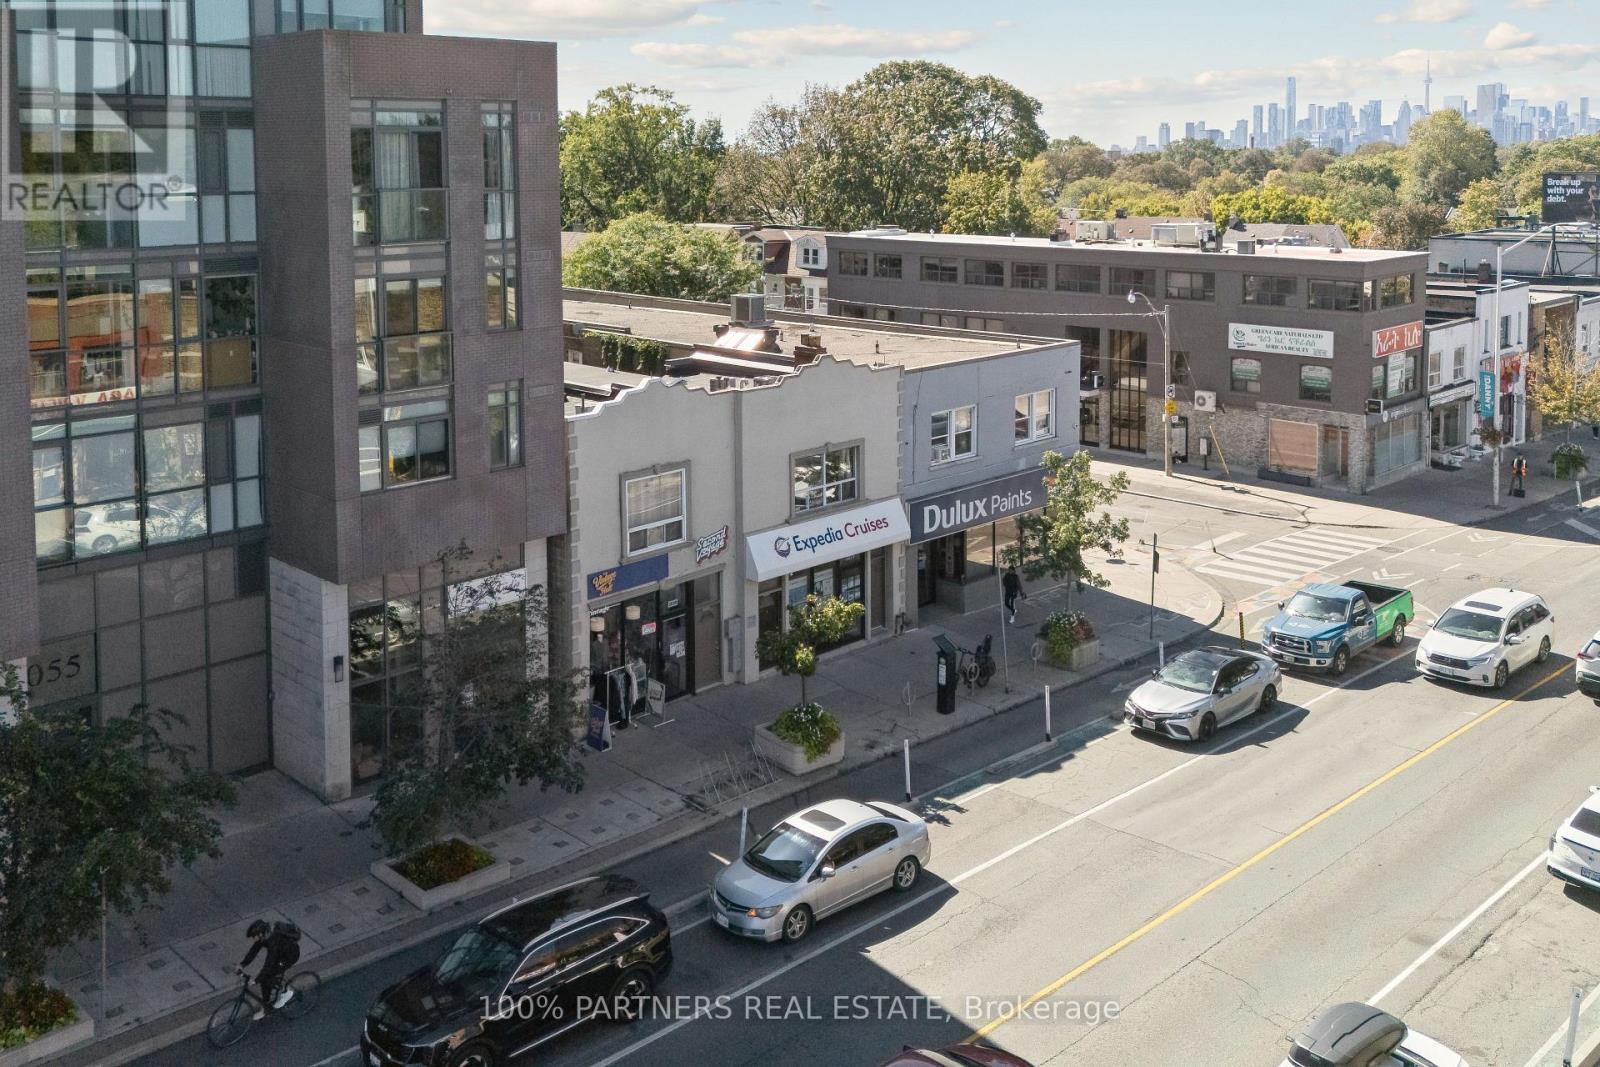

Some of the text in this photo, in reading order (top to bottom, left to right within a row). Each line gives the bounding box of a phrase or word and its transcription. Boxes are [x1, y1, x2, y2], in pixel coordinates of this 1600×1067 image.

[1547, 177, 1581, 188] Break up
[1547, 186, 1584, 197] with your
[923, 488, 1033, 534] Dulux Paints
[792, 517, 889, 553] Expedia Cruises
